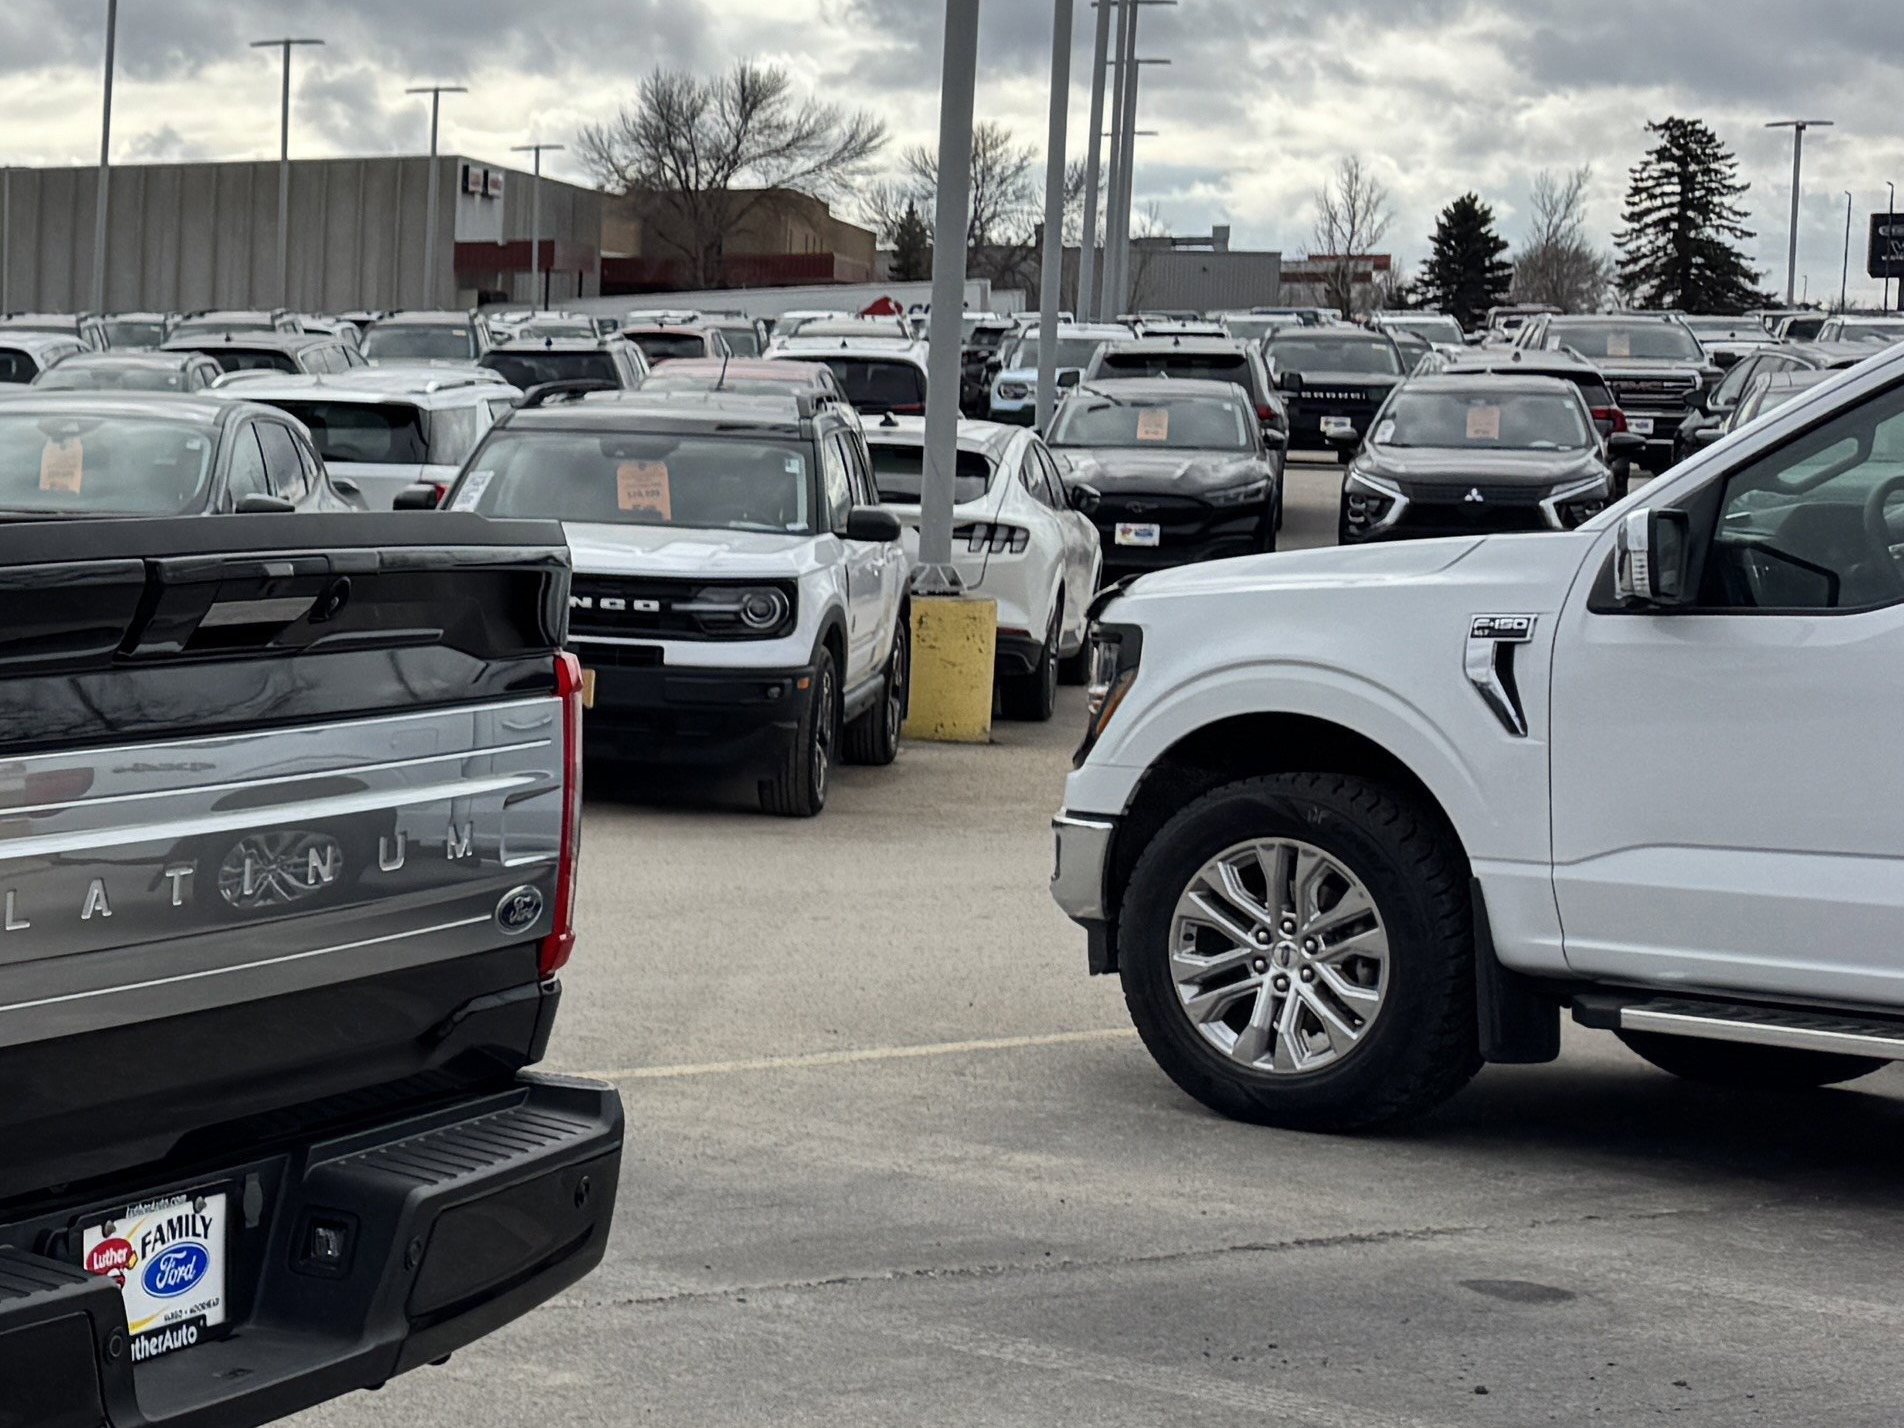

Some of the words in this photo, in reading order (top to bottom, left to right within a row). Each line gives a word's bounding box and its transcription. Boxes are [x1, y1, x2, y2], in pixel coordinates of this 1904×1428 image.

[568, 595, 661, 612] NCO
[1473, 618, 1529, 630] F-150
[141, 1213, 213, 1263] FAMILY
[93, 1247, 129, 1270] Luther
[155, 1250, 197, 1290] Ford
[131, 1325, 198, 1362] therAuto
